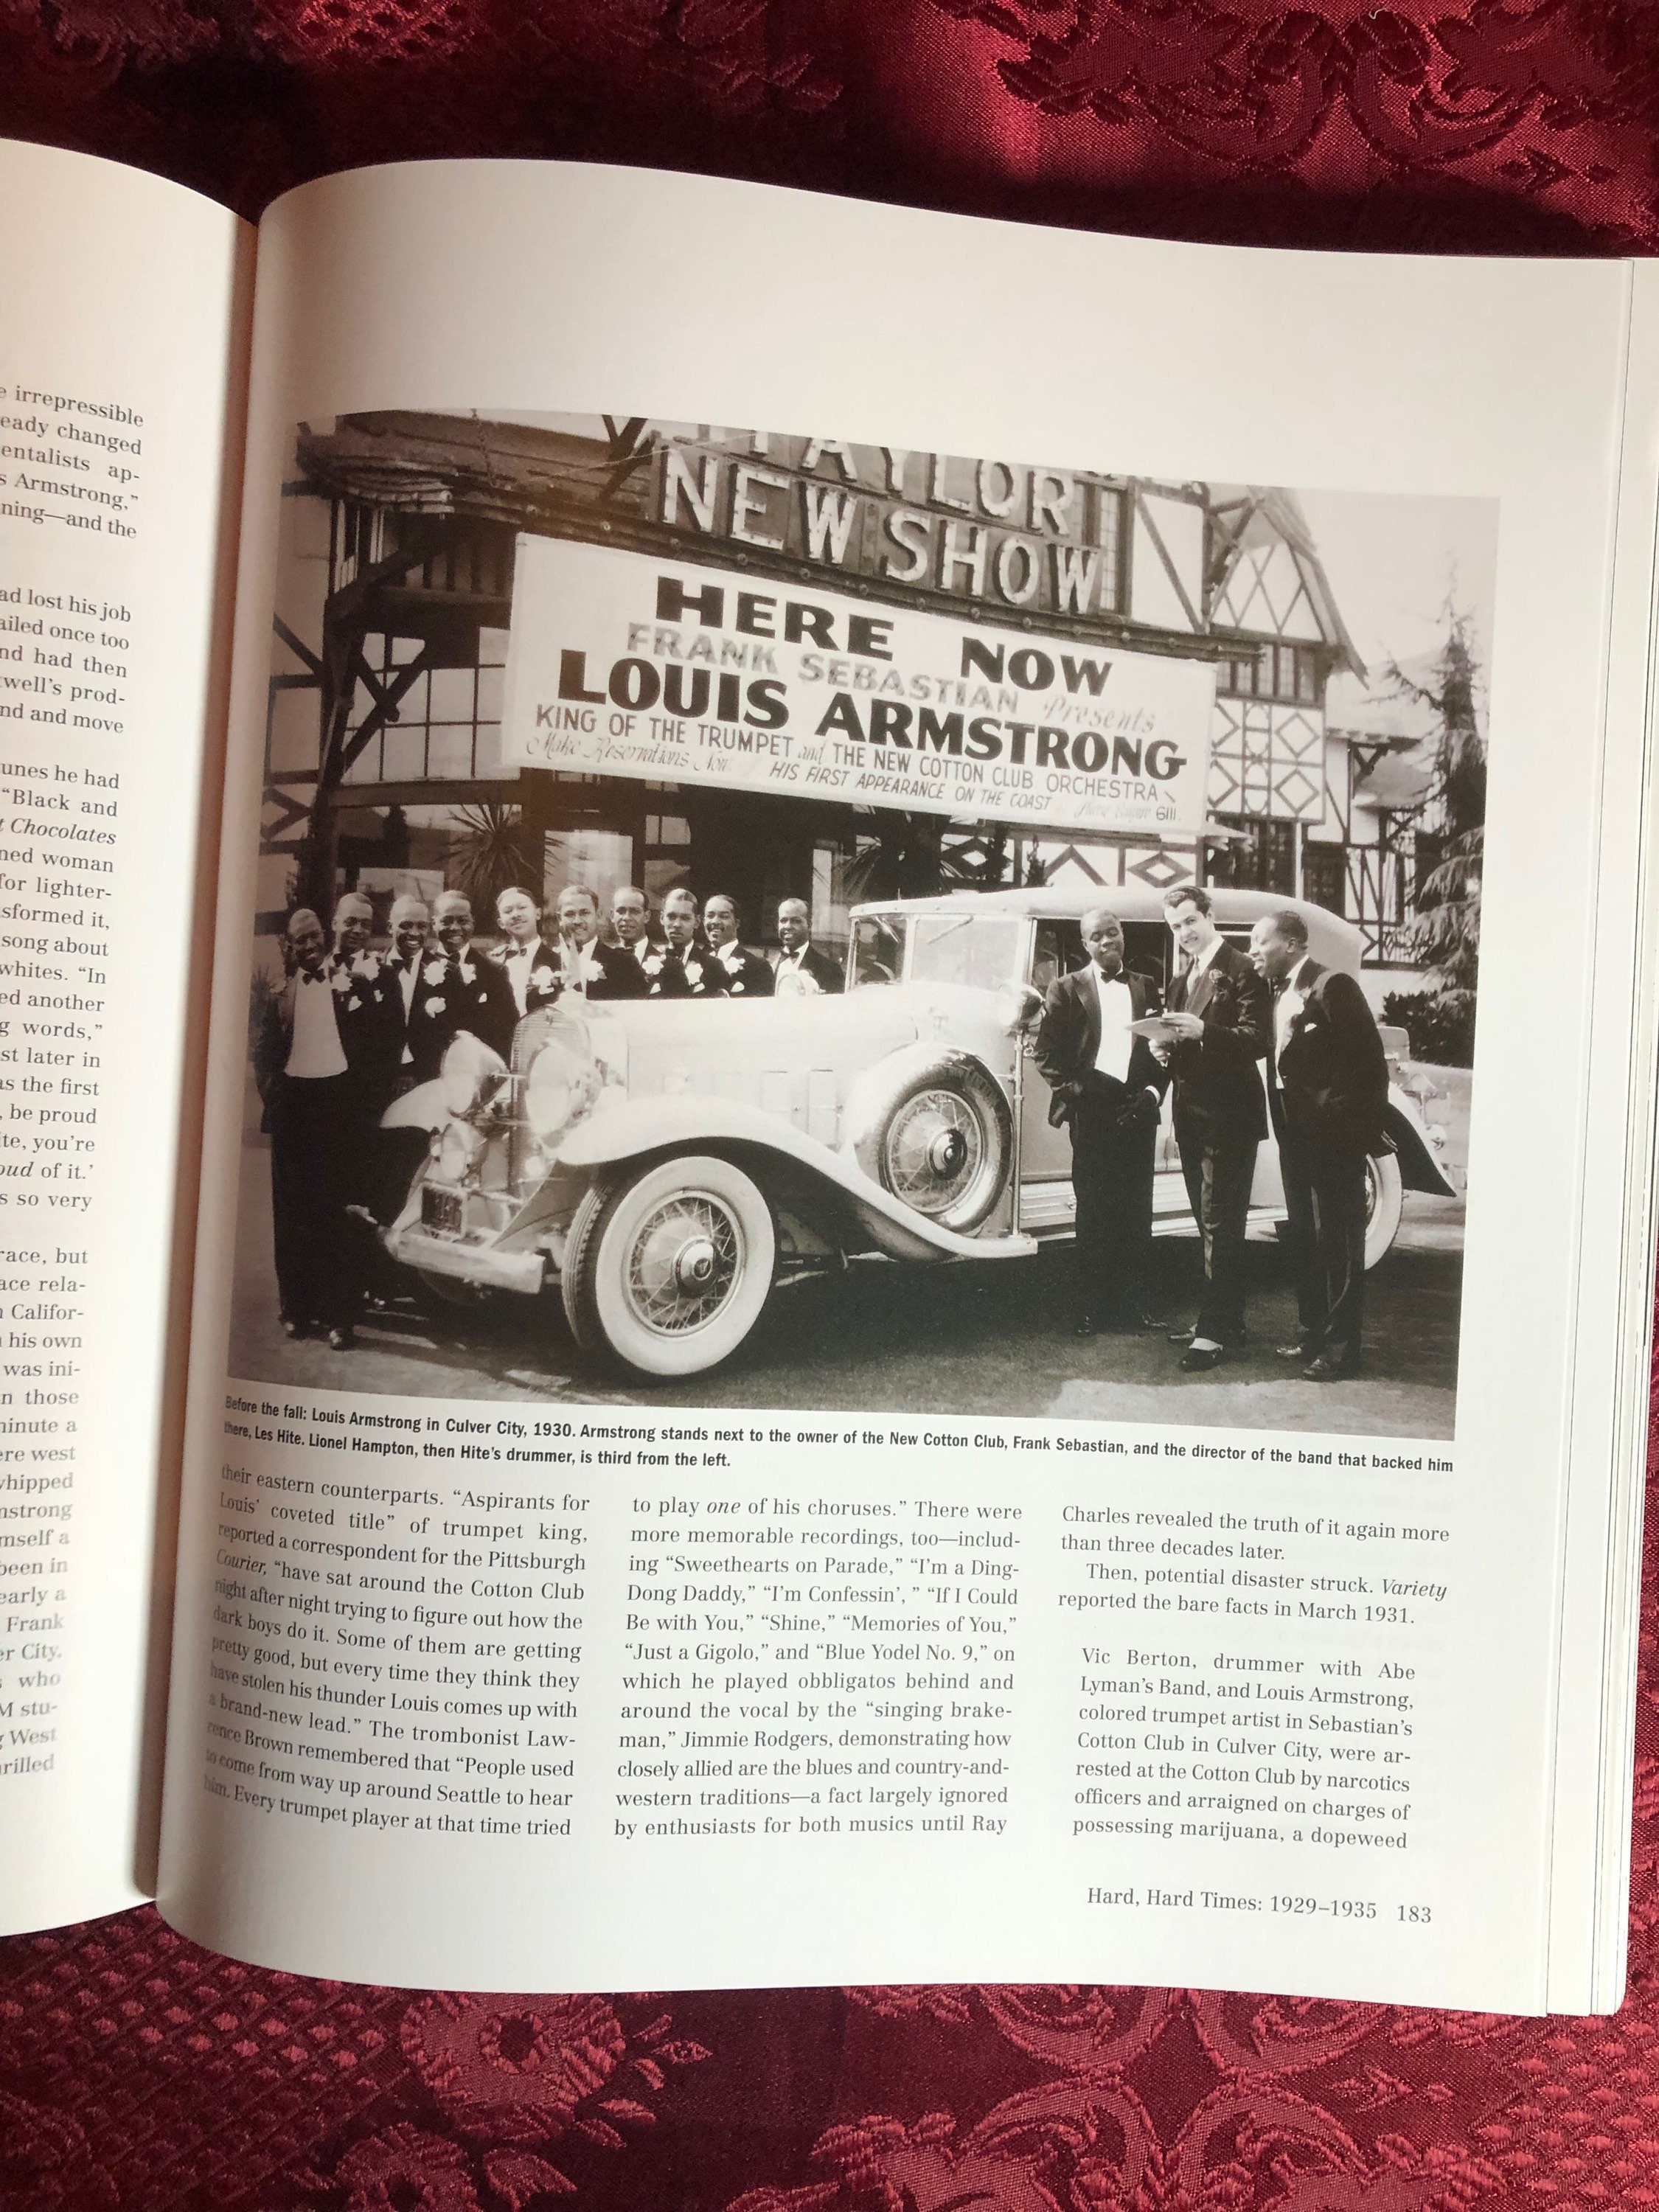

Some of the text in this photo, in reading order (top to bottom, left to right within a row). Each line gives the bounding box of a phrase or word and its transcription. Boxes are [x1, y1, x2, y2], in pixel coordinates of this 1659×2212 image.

[15, 385, 144, 428] irrepressible
[58, 422, 142, 456] changed
[15, 473, 138, 511] Armstrong,”
[660, 446, 1099, 613] NEW SHOW
[27, 589, 131, 622] lost his job
[656, 576, 1113, 697] HERE NOW
[34, 647, 128, 678] had then
[627, 622, 1155, 734] FRANK SEBASTIAN Presents
[557, 649, 1186, 782] LOUIS ARMSTRONG
[536, 704, 1158, 802] KING OF THE TRUMPET and THE NEW COTTON CLUB ORCHESTRA
[1, 787, 118, 817] “Black and
[769, 761, 799, 781] HIS
[805, 766, 850, 787] FIRST
[855, 772, 945, 800] APPEARANCE
[954, 785, 975, 803] ON
[980, 789, 1004, 806] THE
[1009, 793, 1052, 810] COAST
[11, 818, 116, 845] Chocolates
[43, 852, 114, 873] woman
[27, 994, 105, 1012] another
[23, 1022, 102, 1041] words,”
[12, 1304, 84, 1321] Califor-
[25, 1388, 80, 1405] those
[223, 1420, 731, 1467] there, Les Hite. Lionel Hampton, then Hite’s drummer, is third from the left.
[225, 1395, 1453, 1472] Before the fall: Louis Armstrong in Culver City, 1930. Armstrong stands next to the owner of the New Cotton Club, Frank Sebastian, and the director of the band that backed him
[221, 1463, 591, 1512] their eastern counterparts. “Aspirants for
[630, 1526, 1020, 1550] more memorable recordings, too—includ-
[1062, 1505, 1450, 1542] Charles revealed the truth of it again more
[7, 1613, 65, 1632] Frank
[1058, 1592, 1414, 1624] reported the bare facts in March 1931.
[213, 1604, 582, 1663] dark boys do it. Some of them are getting
[21, 1643, 62, 1662] City.
[1082, 1647, 1416, 1680] Vic Berton, drummer with Abe
[622, 1672, 1014, 1694] which he played obbligatos behind and
[220, 1692, 303, 1728] brand-new
[308, 1711, 362, 1735] lead.”
[369, 1719, 405, 1739] The
[411, 1725, 520, 1747] trombonist
[526, 1730, 576, 1747] Law-
[613, 1815, 1007, 1840] by enthusiasts for both musics until Ray
[1087, 1887, 1431, 1924] Hard, Hard Times: 1929–1935 183
